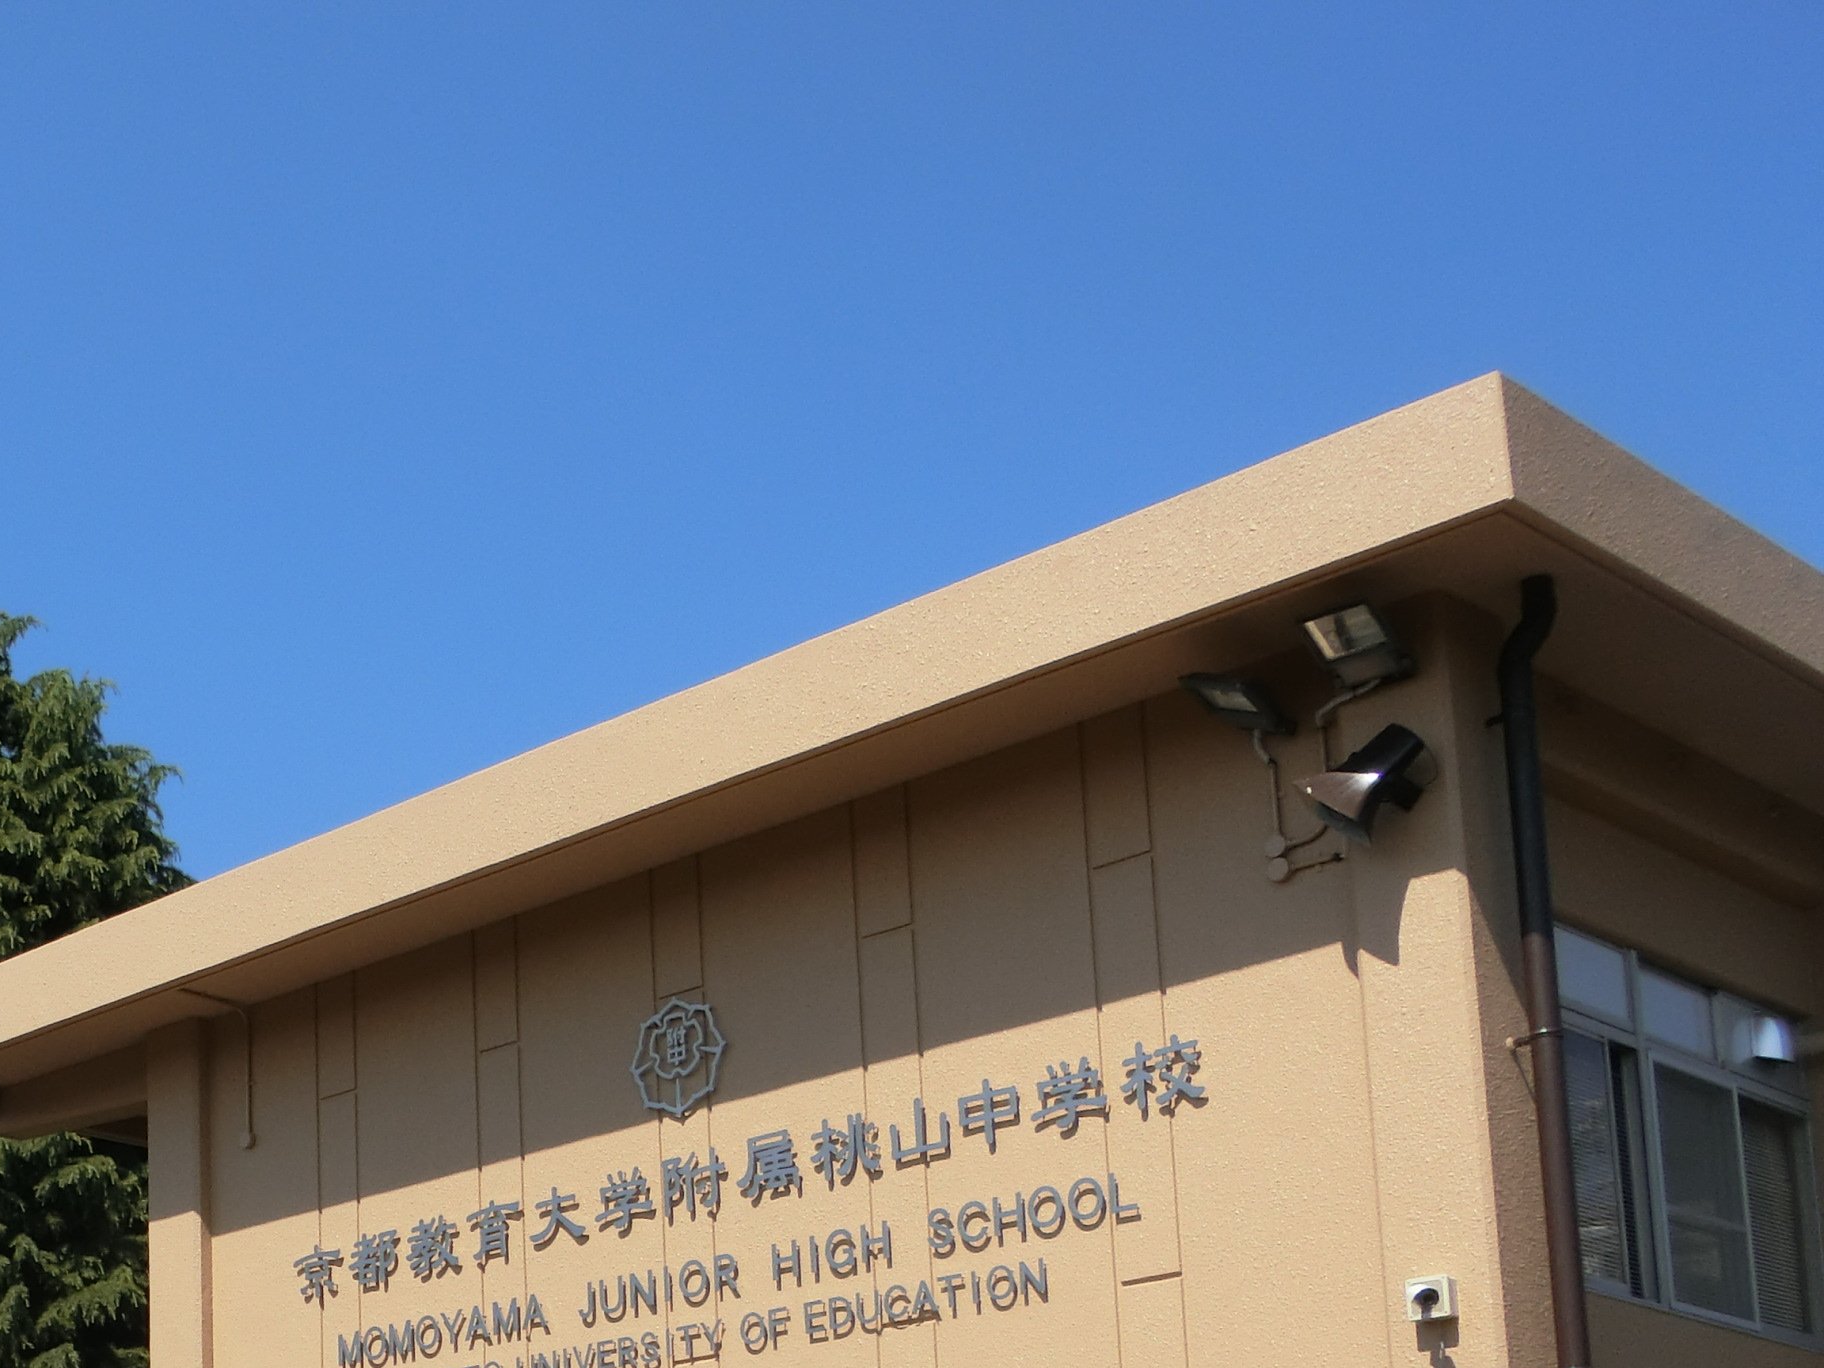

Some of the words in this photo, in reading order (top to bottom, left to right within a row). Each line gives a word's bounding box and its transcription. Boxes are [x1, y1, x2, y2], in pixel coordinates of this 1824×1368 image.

[293, 1034, 1206, 1300] 京都教育大学附属桃山中学校
[580, 1253, 739, 1322] JUNIOR
[771, 1220, 891, 1284] HIGH
[927, 1172, 1139, 1250] SCHOOL
[740, 1306, 789, 1349] OF
[804, 1257, 1048, 1334] EDUCATION
